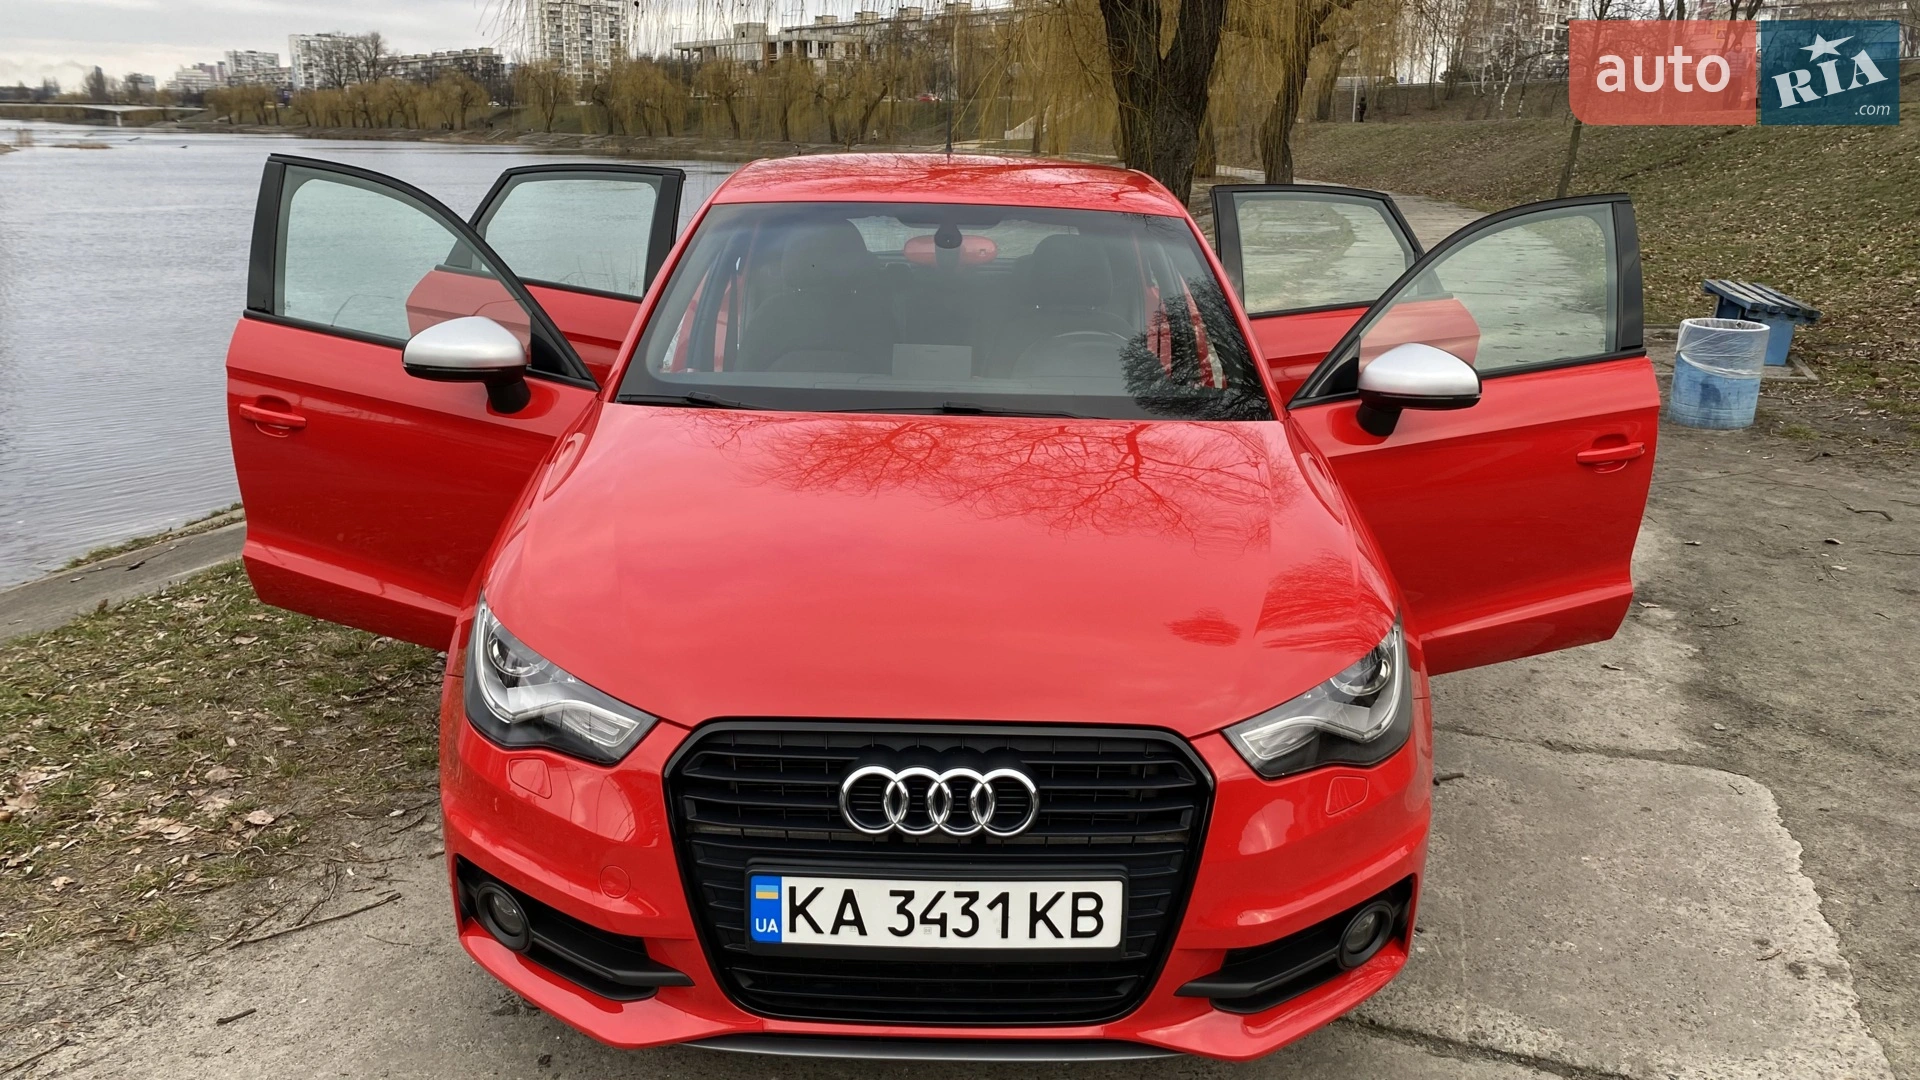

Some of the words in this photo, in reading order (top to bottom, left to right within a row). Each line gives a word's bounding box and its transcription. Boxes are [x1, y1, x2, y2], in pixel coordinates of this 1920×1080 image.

[755, 918, 779, 934] UA
[787, 886, 868, 937] KA
[887, 889, 1010, 939] 3431
[1028, 891, 1104, 939] KB
